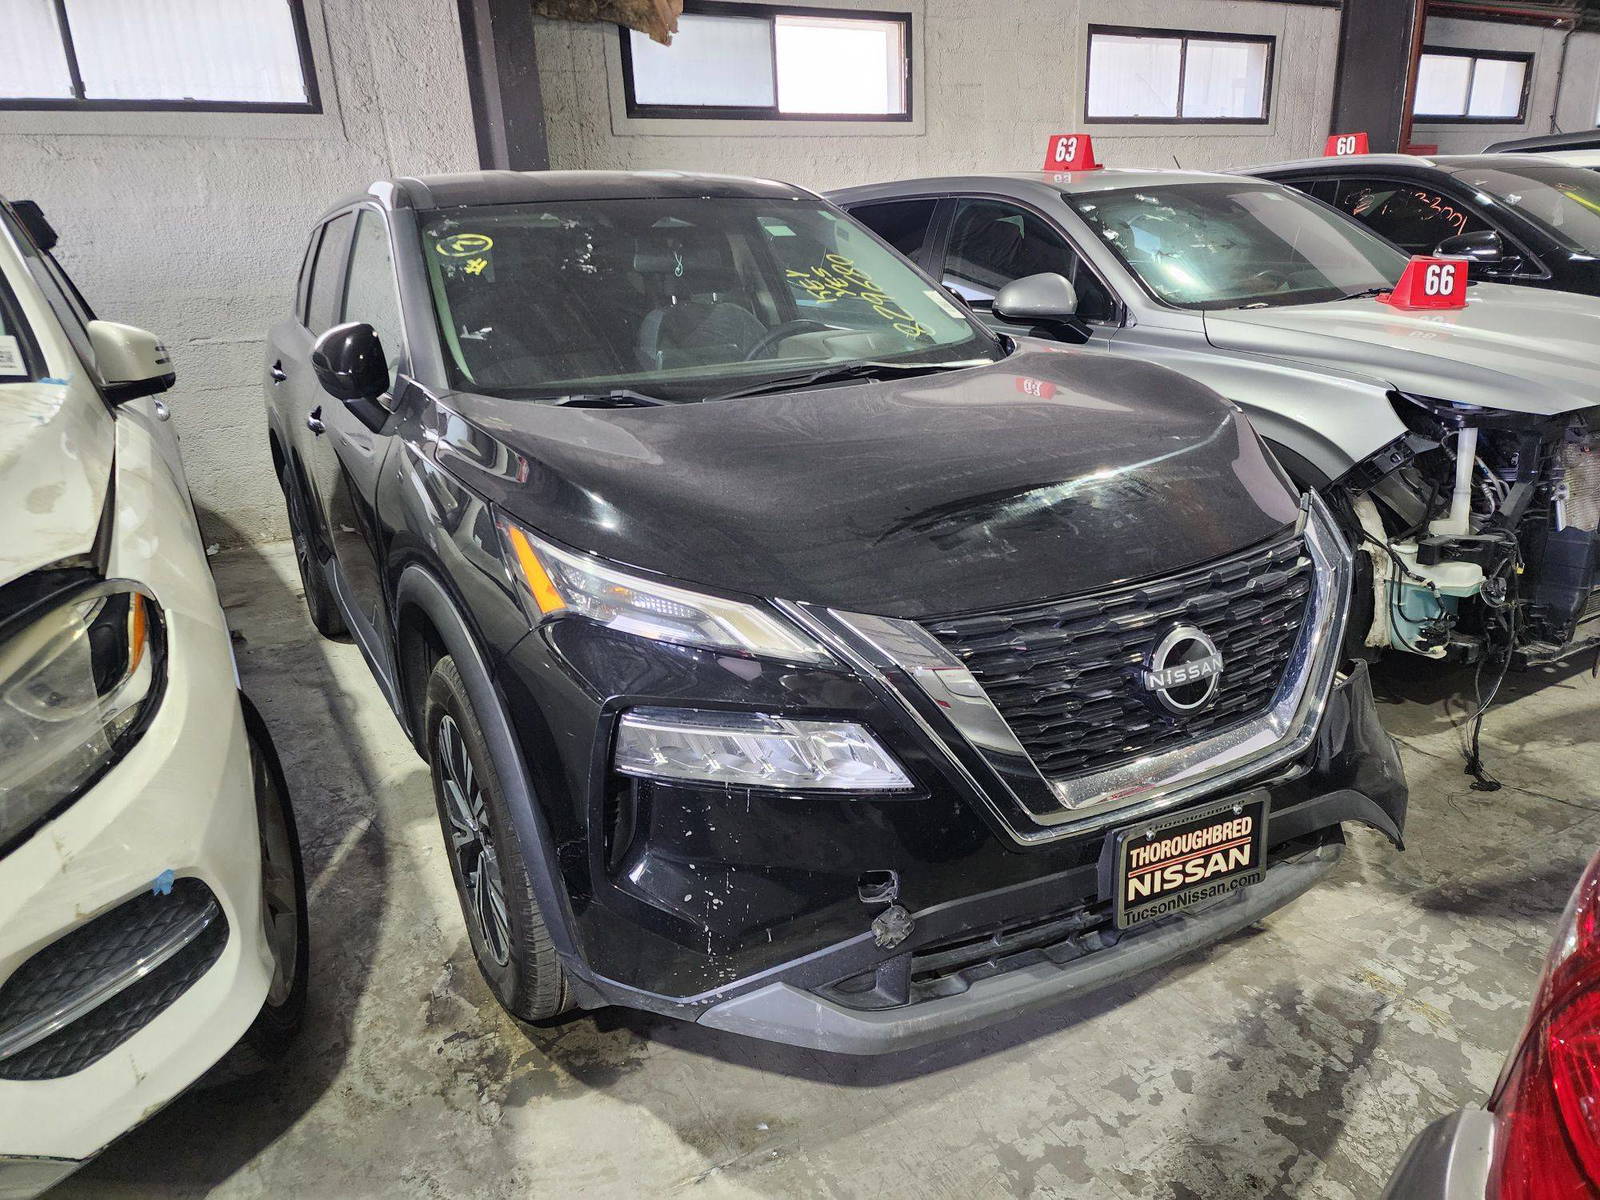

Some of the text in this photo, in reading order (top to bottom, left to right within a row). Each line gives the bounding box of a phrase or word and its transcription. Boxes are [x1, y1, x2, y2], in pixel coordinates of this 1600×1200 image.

[1055, 137, 1078, 162] 63
[1336, 136, 1356, 156] 60
[1425, 264, 1455, 295] 66
[1148, 653, 1222, 688] NISSAN
[1130, 816, 1252, 868] THOROUGHBRED
[1127, 844, 1251, 902] NISSAN
[1124, 871, 1261, 926] TucsonNissan.com
